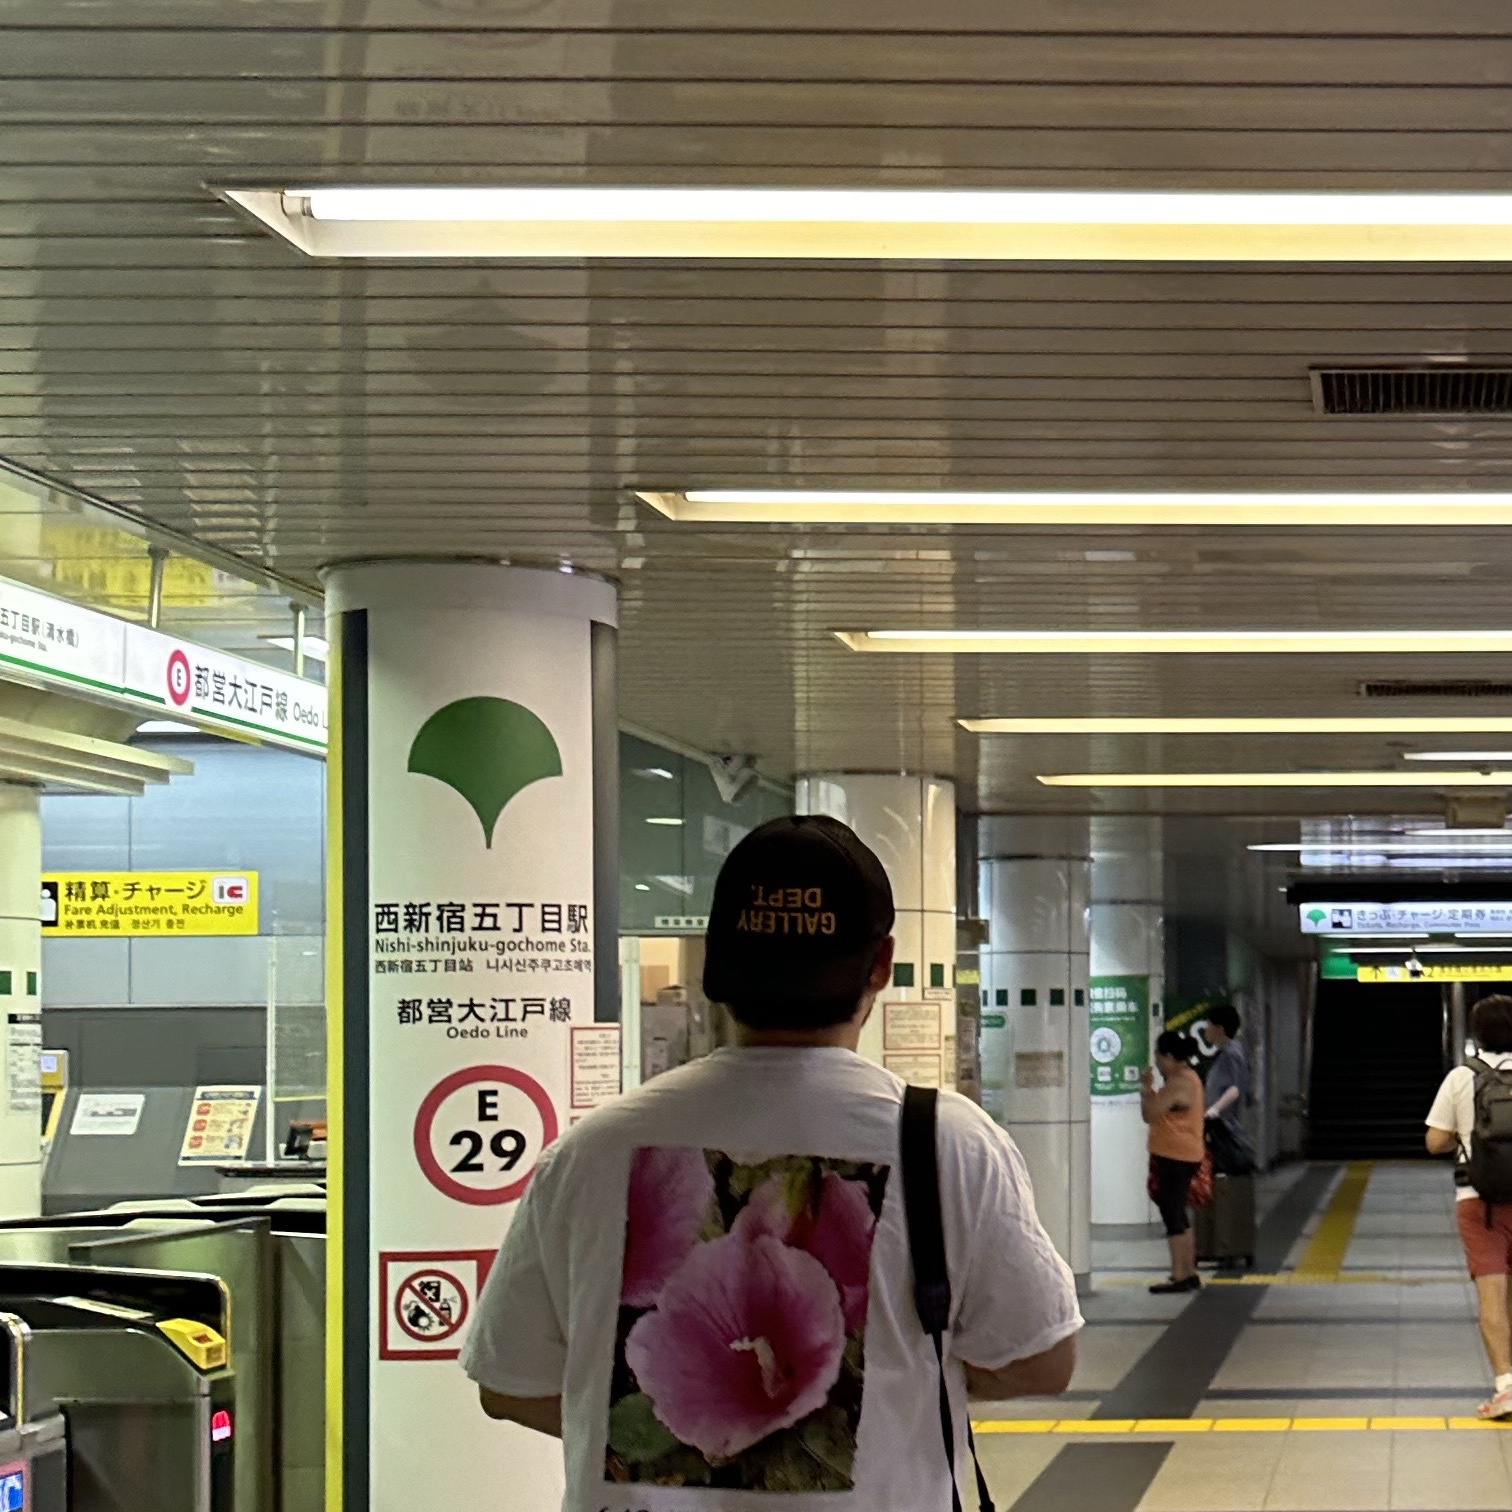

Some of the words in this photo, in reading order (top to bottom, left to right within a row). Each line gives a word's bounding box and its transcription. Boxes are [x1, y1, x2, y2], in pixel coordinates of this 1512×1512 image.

[176, 668, 182, 687] E
[195, 662, 288, 722] 都営大江戸線
[293, 701, 319, 727] Oedo
[65, 879, 207, 902] 精算・チャージ
[751, 886, 823, 908] DEPT.
[64, 904, 92, 915] Fare
[96, 904, 177, 917] Adjustment,
[182, 904, 243, 916] Recharge
[375, 902, 588, 934] 西新宿五丁目駅
[737, 909, 836, 936] GALLERY
[375, 936, 566, 956] Nishi-shinjuku-gochome
[570, 938, 591, 953] Sta.
[375, 958, 473, 974] 西新宿五丁目站
[397, 998, 571, 1025] 都営大江戸線
[446, 1026, 490, 1039] Oedo
[496, 1026, 528, 1039] Line
[478, 1090, 498, 1122] E
[449, 1129, 526, 1173] 29
